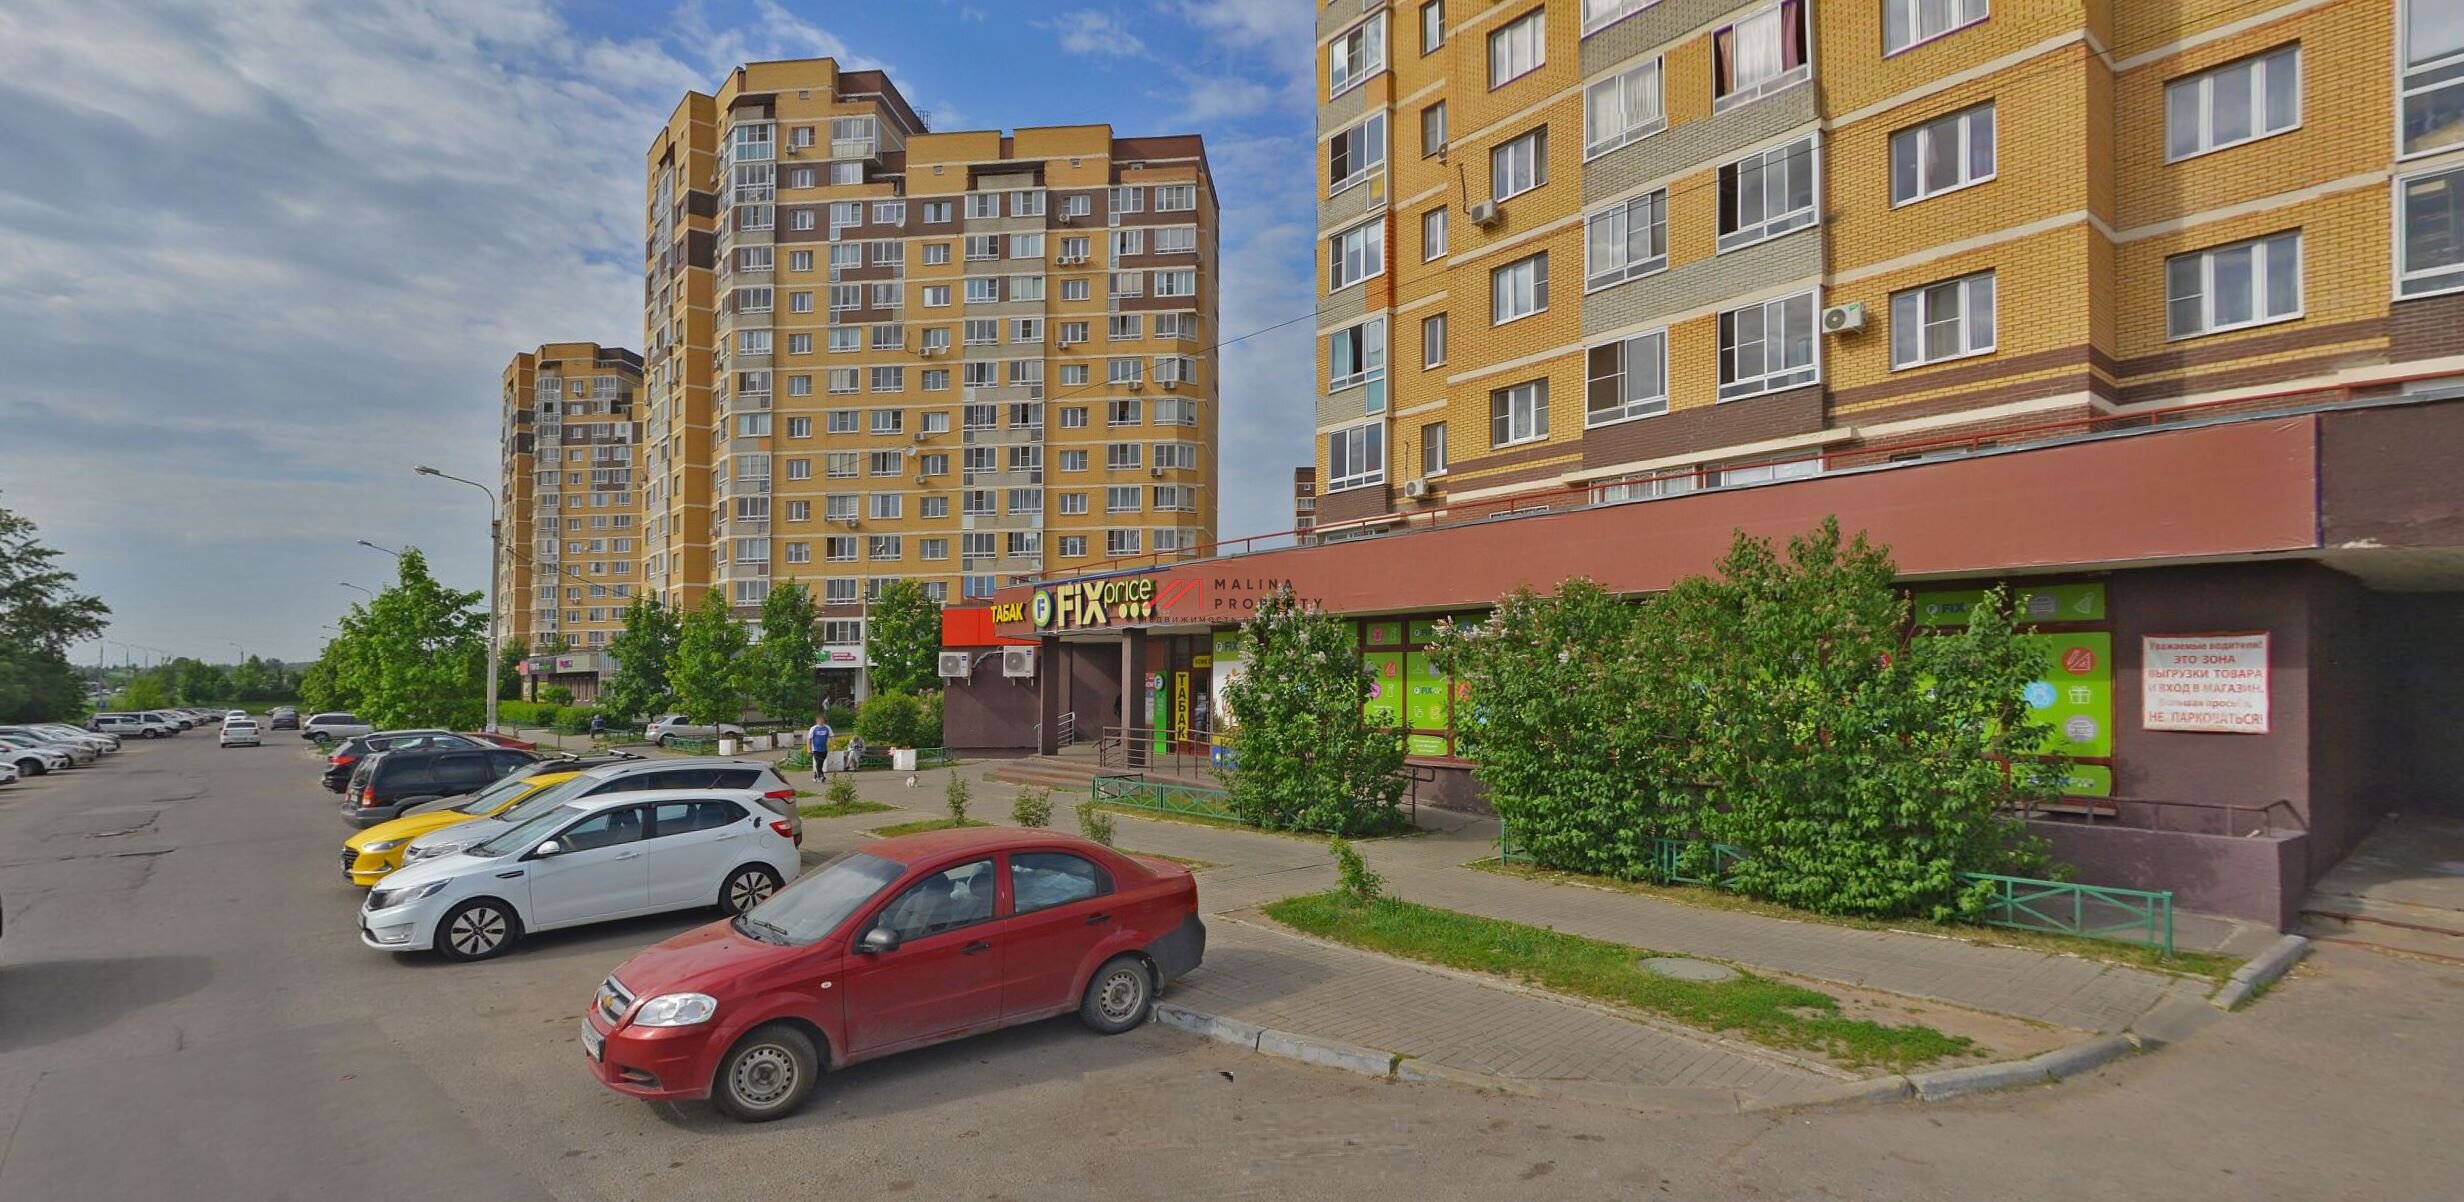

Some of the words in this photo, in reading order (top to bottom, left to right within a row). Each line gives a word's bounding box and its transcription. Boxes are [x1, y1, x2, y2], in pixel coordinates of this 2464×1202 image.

[1104, 578, 1152, 608] price
[990, 602, 1025, 623] ТАБАК
[2174, 655, 2197, 664] ЭТО
[2202, 655, 2236, 664] ЗОНА
[2149, 669, 2209, 678] ВЫГРУЗКИ
[2214, 669, 2263, 678] ТОВАРА
[2158, 683, 2190, 693] ВХОД
[1178, 674, 1186, 739] ТАБАК
[2149, 712, 2165, 722] НЕ
